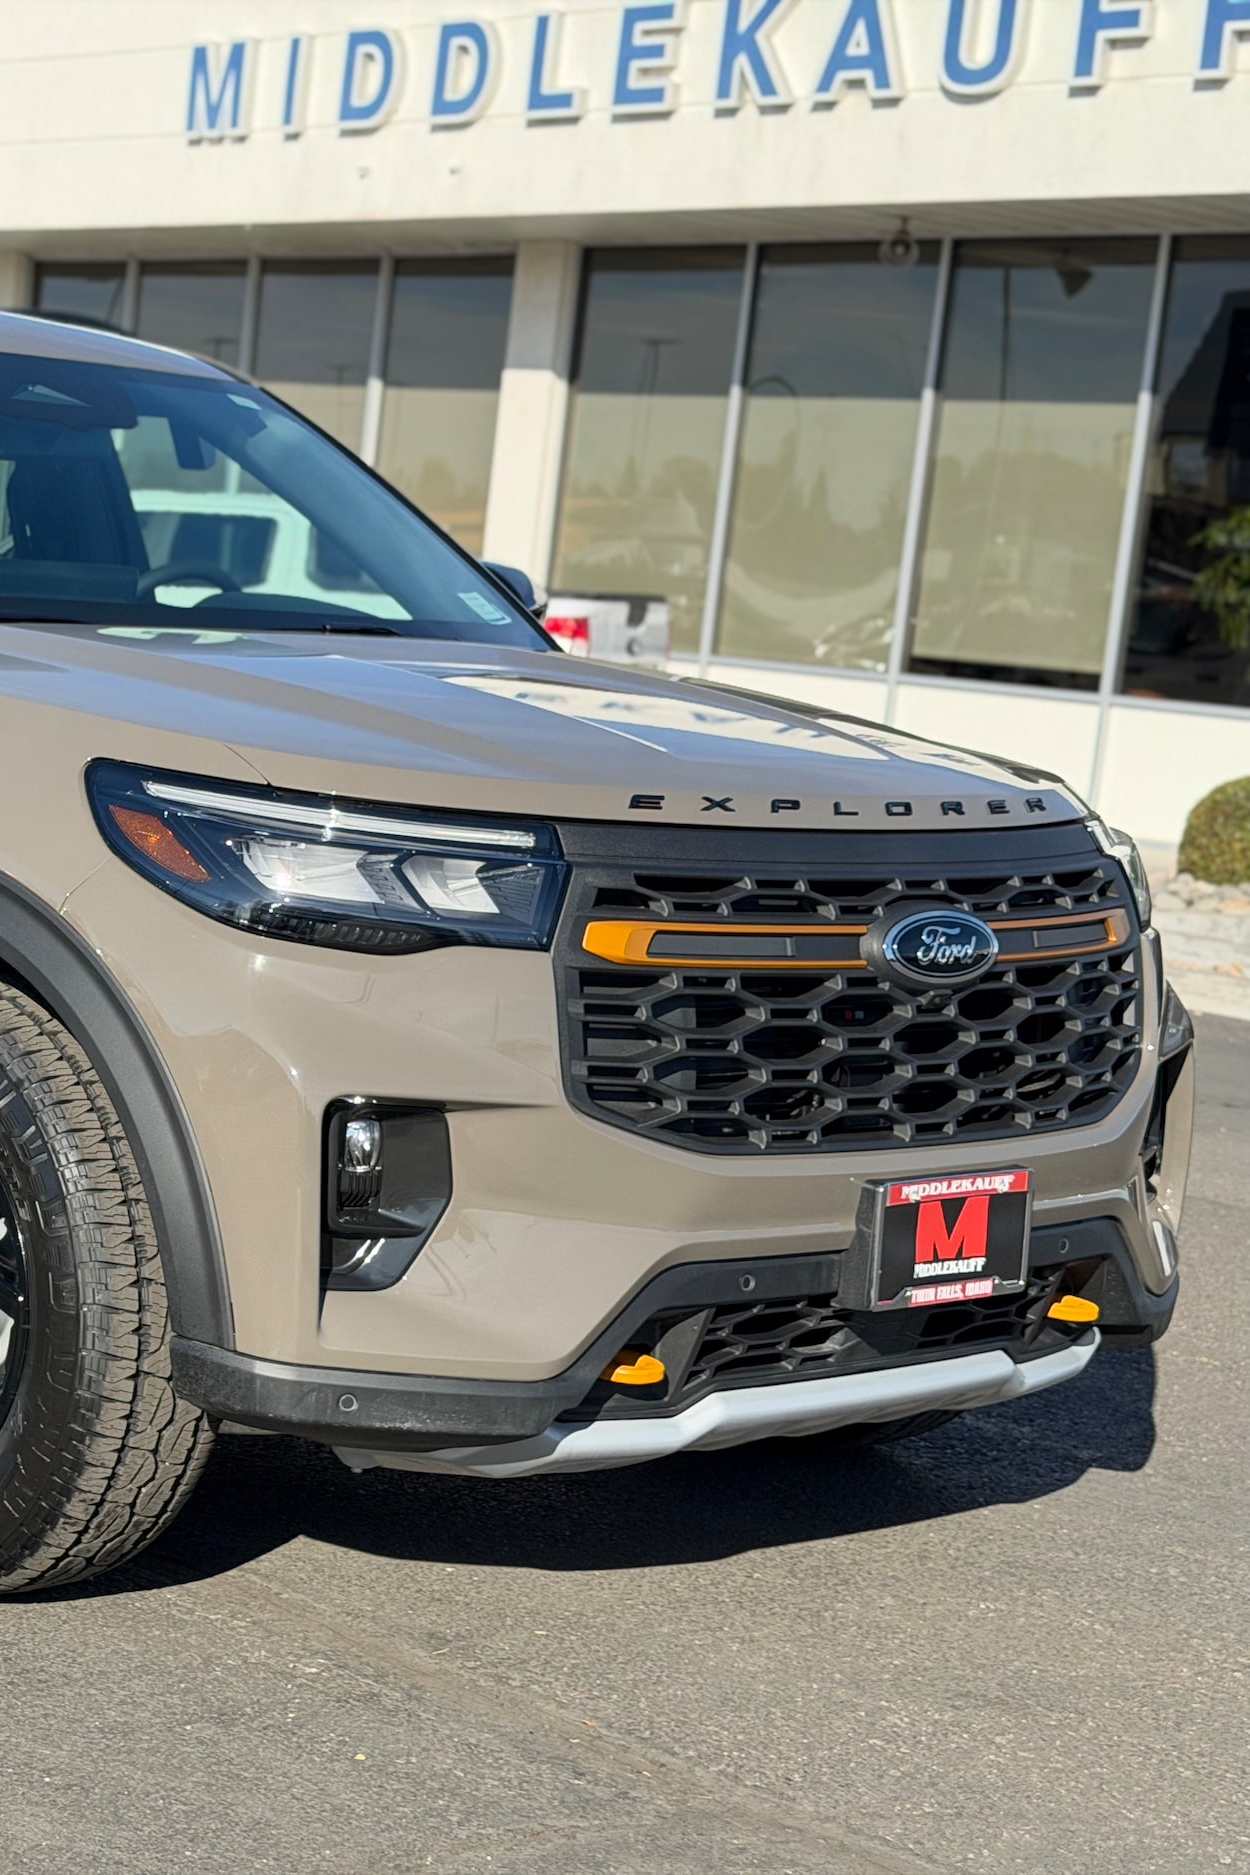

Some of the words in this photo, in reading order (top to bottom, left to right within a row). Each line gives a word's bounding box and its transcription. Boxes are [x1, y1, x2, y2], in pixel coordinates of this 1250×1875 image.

[628, 794, 1047, 818] EXPLORER
[916, 925, 977, 966] Ford
[901, 1174, 1015, 1199] MIDDLEKAUFF
[915, 1195, 991, 1264] M
[913, 1256, 987, 1279] MIDDLEKAUFF
